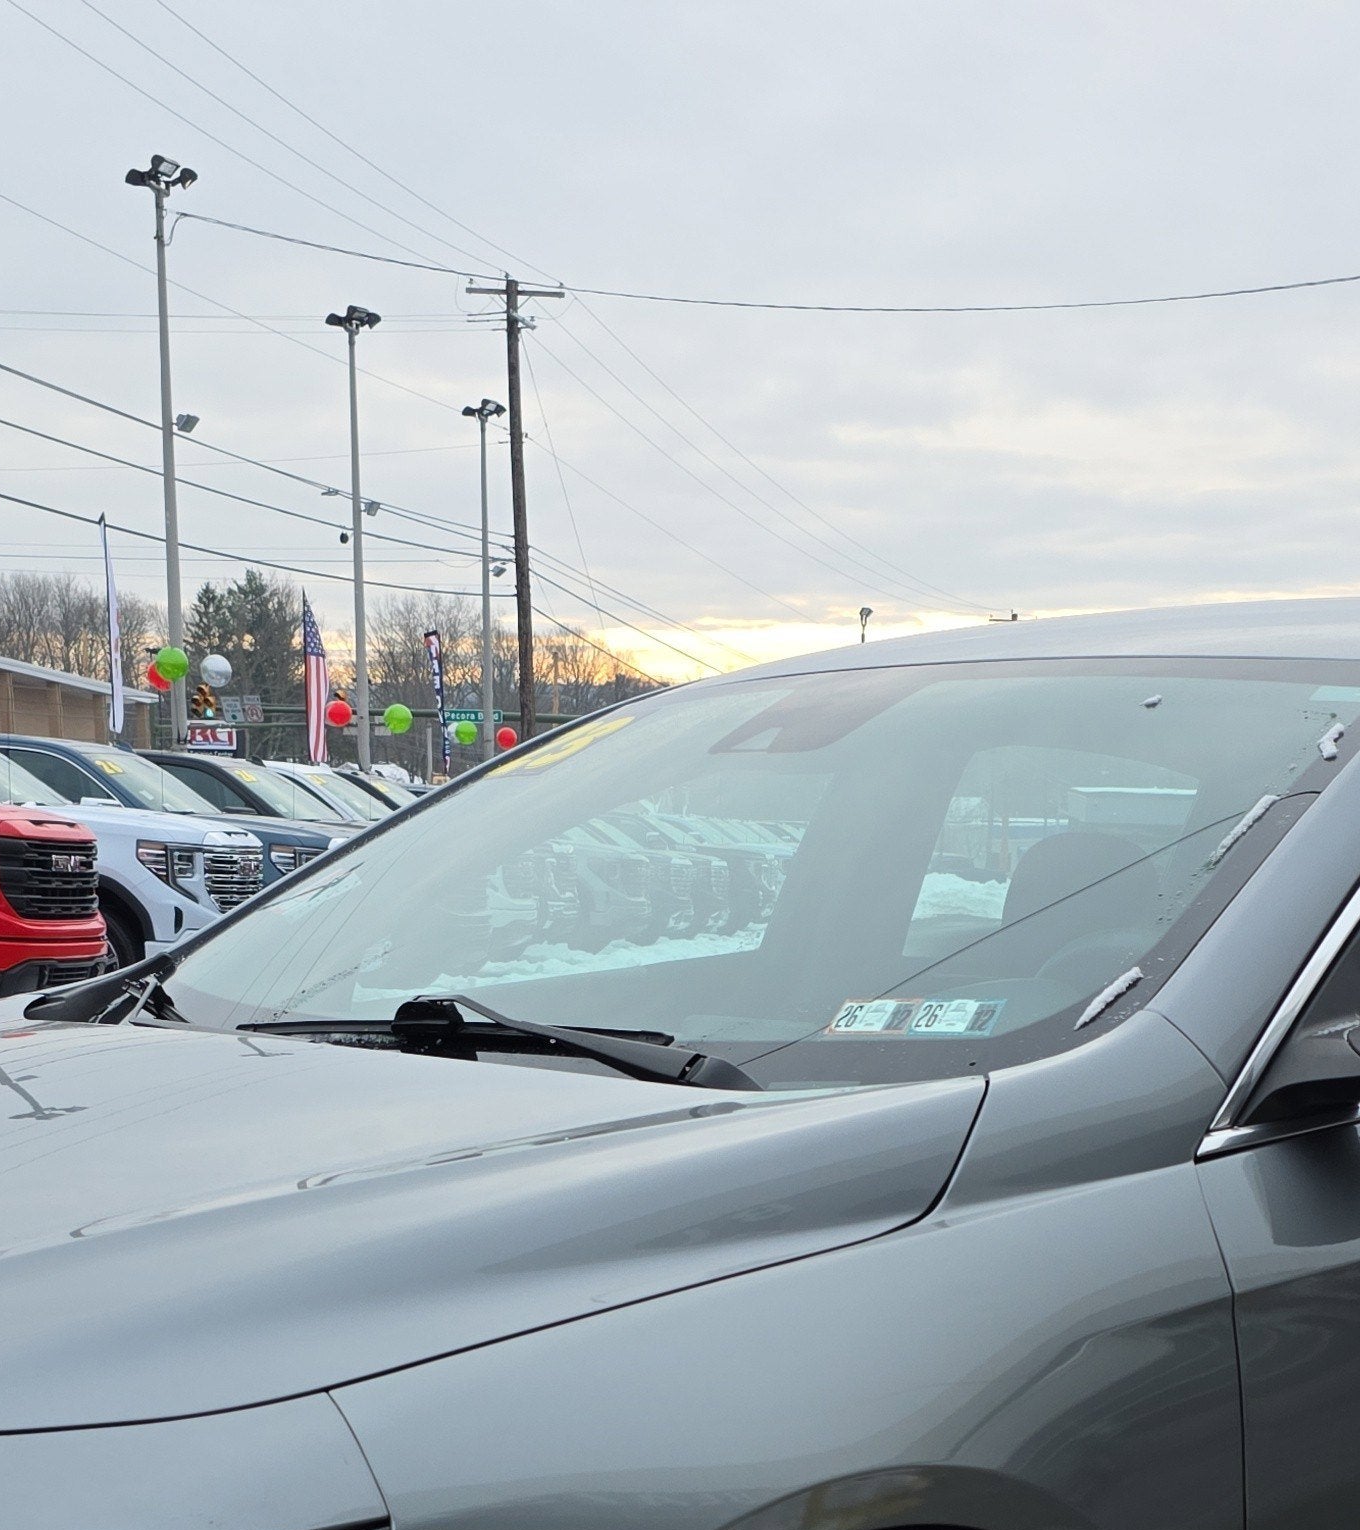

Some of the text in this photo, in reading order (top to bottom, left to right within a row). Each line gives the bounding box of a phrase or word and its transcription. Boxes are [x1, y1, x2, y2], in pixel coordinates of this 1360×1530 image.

[444, 711, 499, 720] Pecora Bd
[834, 1004, 864, 1028] 26
[914, 1004, 943, 1028] 26
